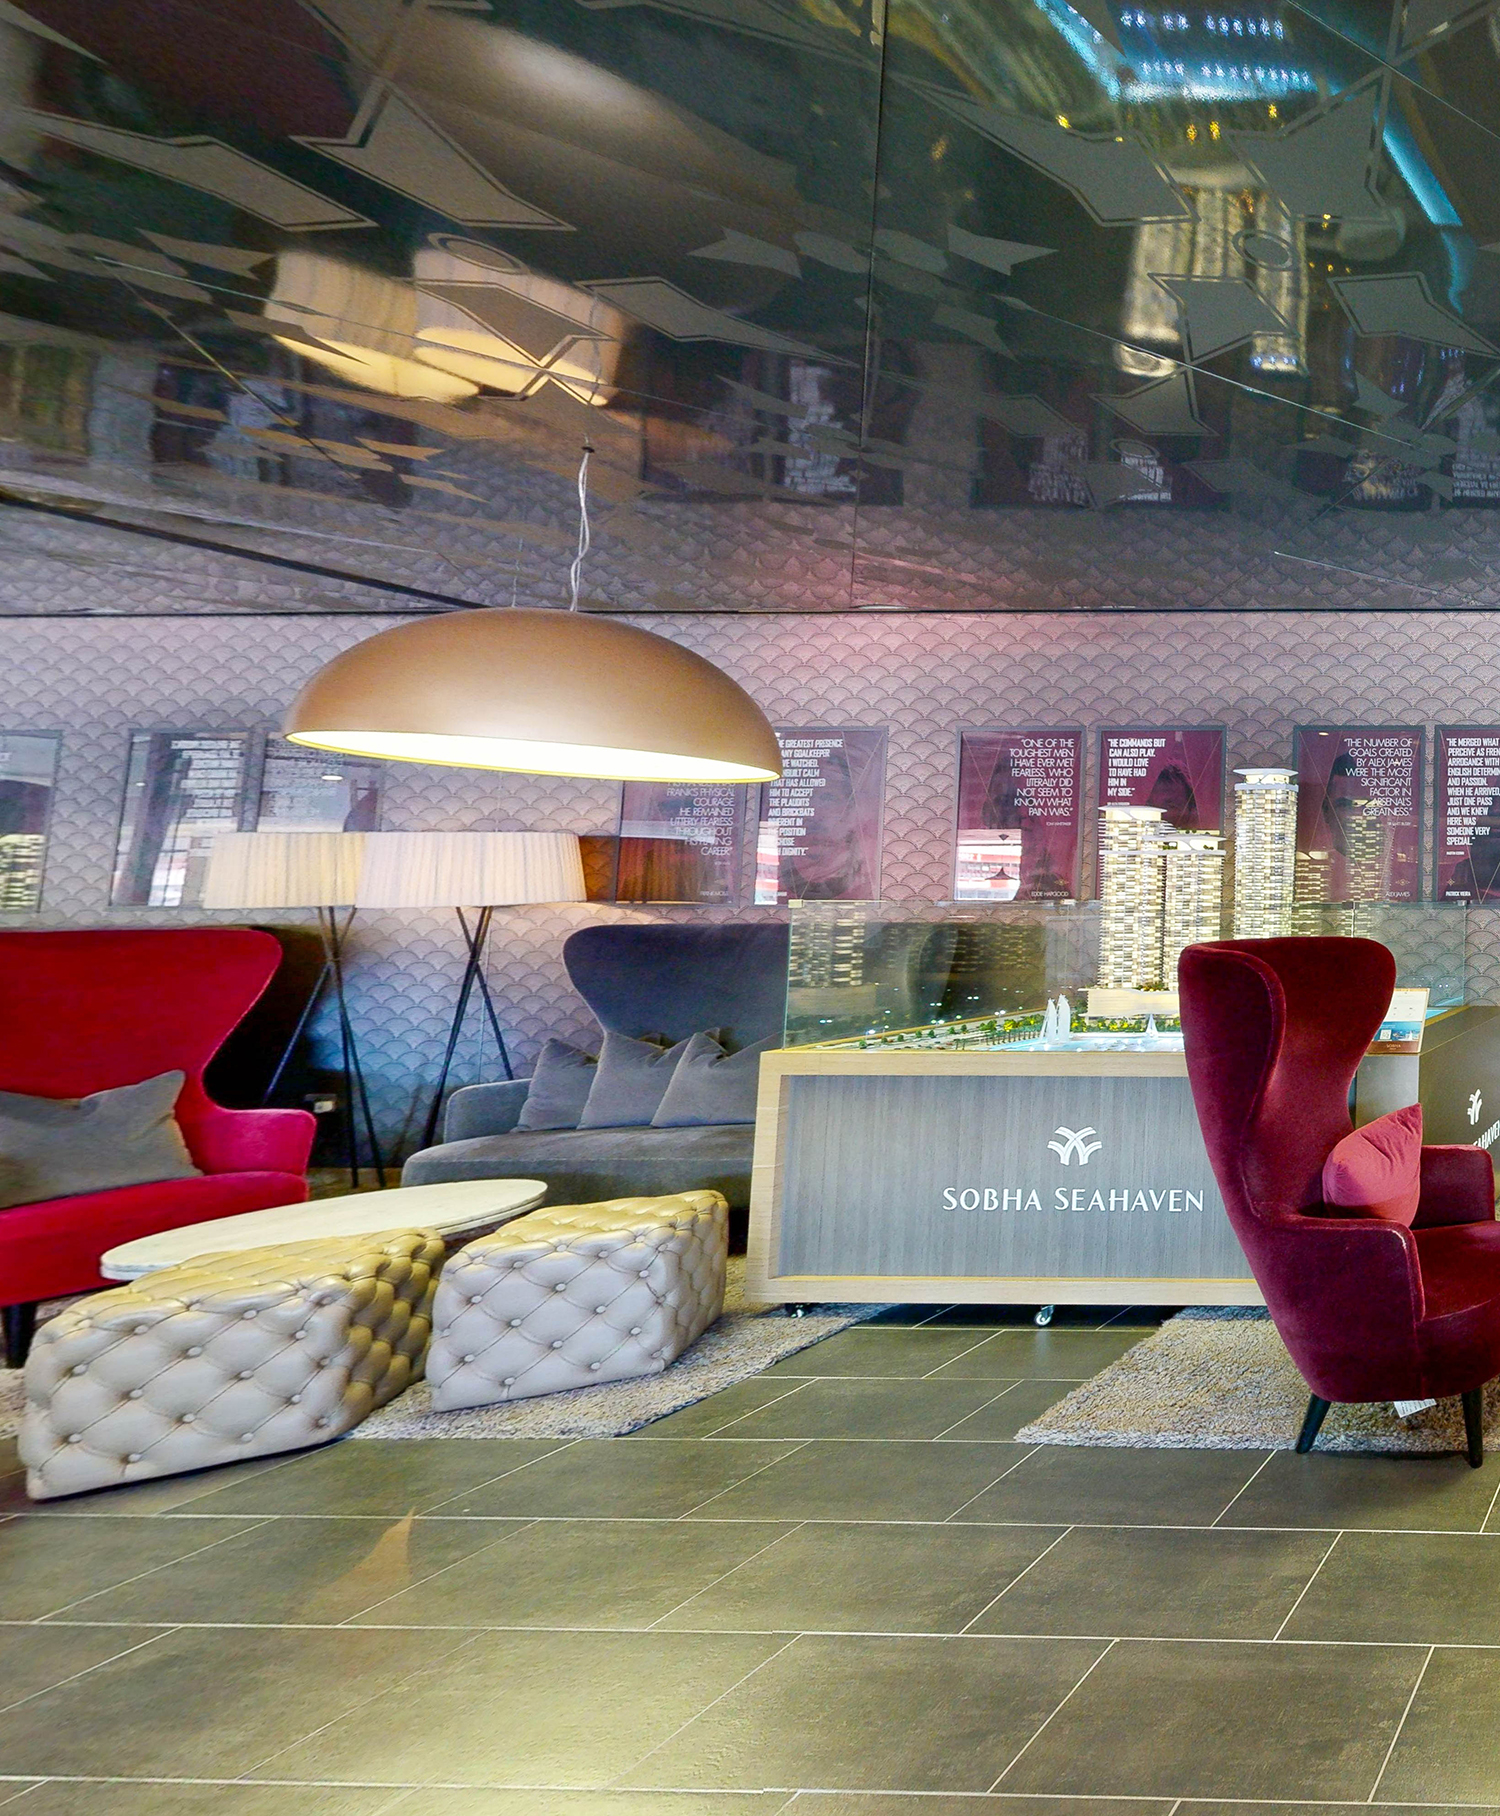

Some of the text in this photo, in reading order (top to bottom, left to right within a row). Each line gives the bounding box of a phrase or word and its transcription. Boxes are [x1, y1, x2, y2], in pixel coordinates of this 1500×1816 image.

[785, 739, 815, 748] GREATEST
[815, 739, 844, 748] PRESENCE
[1021, 738, 1075, 748] "ONE OF THE
[1119, 738, 1152, 747] COMMANDS
[1153, 738, 1166, 747] BUT
[1363, 738, 1399, 747] NUMBER
[1400, 738, 1413, 747] OF
[1458, 737, 1481, 747] MERGED
[1482, 737, 1499, 747] WHAT
[794, 749, 830, 758] GOALKEEPER
[1009, 748, 1075, 758] TOUGHEST MEN
[1109, 748, 1156, 757] CAN ALSO PLAY.
[1348, 748, 1413, 757] GOALS CREATED
[1447, 747, 1475, 757] PERCEIVE
[1476, 747, 1485, 757] AS
[791, 758, 819, 767] WATCHED.
[1014, 758, 1035, 767] HAVE
[1036, 758, 1055, 767] EVER
[1112, 758, 1133, 767] WOULD
[1133, 758, 1149, 767] LOVE
[1356, 758, 1413, 768] BY ALEX JAMES
[1447, 757, 1484, 766] ARROGANCE
[1484, 757, 1500, 766] WITH
[803, 768, 820, 777] CALM
[1048, 768, 1074, 777] WHO
[1108, 768, 1147, 777] TO HAVE HAD
[1345, 767, 1413, 777] WERE THE MOST
[1447, 767, 1472, 776] ENGLISH
[786, 778, 798, 787] HAS
[799, 778, 827, 787] ALLOWED
[1026, 778, 1074, 787] LITERALLY DID
[1120, 777, 1127, 787] IN
[1361, 777, 1413, 787] SIGNIFICANT
[1447, 777, 1488, 786] AND PASSION.
[769, 788, 814, 797] HIM TO ACCEPT
[1016, 787, 1073, 797] NOT SEEM TO
[1107, 787, 1117, 797] MY
[1369, 787, 1412, 797] FACTOR IN
[1447, 787, 1464, 796] WHEN
[1465, 787, 1473, 796] HE
[693, 797, 736, 807] COURAGE
[769, 798, 810, 807] THE PLAUDITS
[1013, 797, 1073, 807] KNOW WHAT
[1447, 797, 1493, 806] JUST ONE PASS
[679, 807, 735, 817] HE REMAINED
[768, 807, 815, 816] AND BRICKBATS
[1028, 807, 1047, 817] PAIN
[1446, 806, 1489, 816] AND WE KNEW
[670, 817, 734, 826] UTTERLY FEARLESS
[796, 817, 804, 826] IN
[1446, 816, 1477, 826] HERE WAS
[780, 827, 807, 836] POSITION
[1446, 826, 1491, 836] SOMEONE VERY
[942, 1187, 1205, 1213] SOBHA SEAHAVEN
